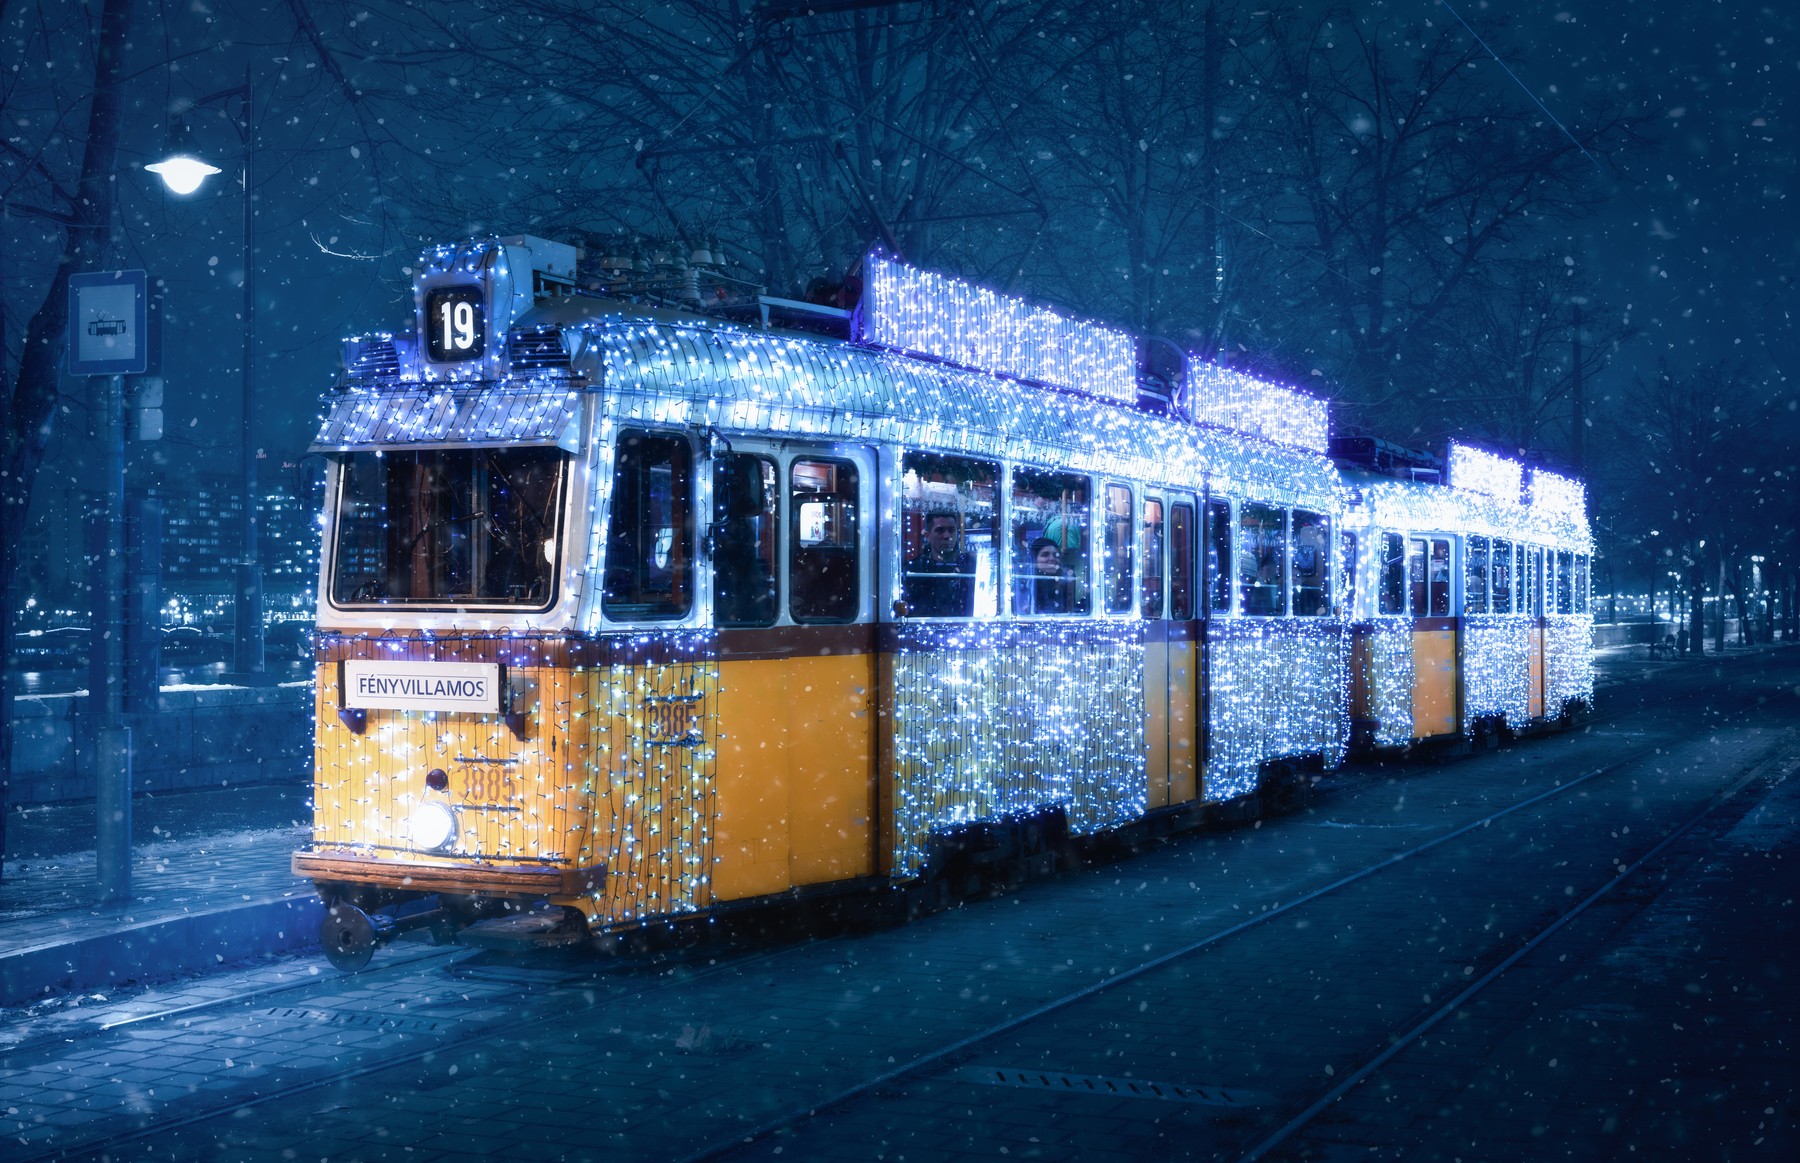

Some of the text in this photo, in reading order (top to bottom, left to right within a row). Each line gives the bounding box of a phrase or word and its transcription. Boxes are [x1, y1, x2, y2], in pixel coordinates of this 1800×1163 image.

[441, 301, 474, 350] 19
[359, 674, 485, 698] FÉNYVILLAMOS
[648, 703, 697, 738] 3885
[457, 765, 516, 803] 3885
